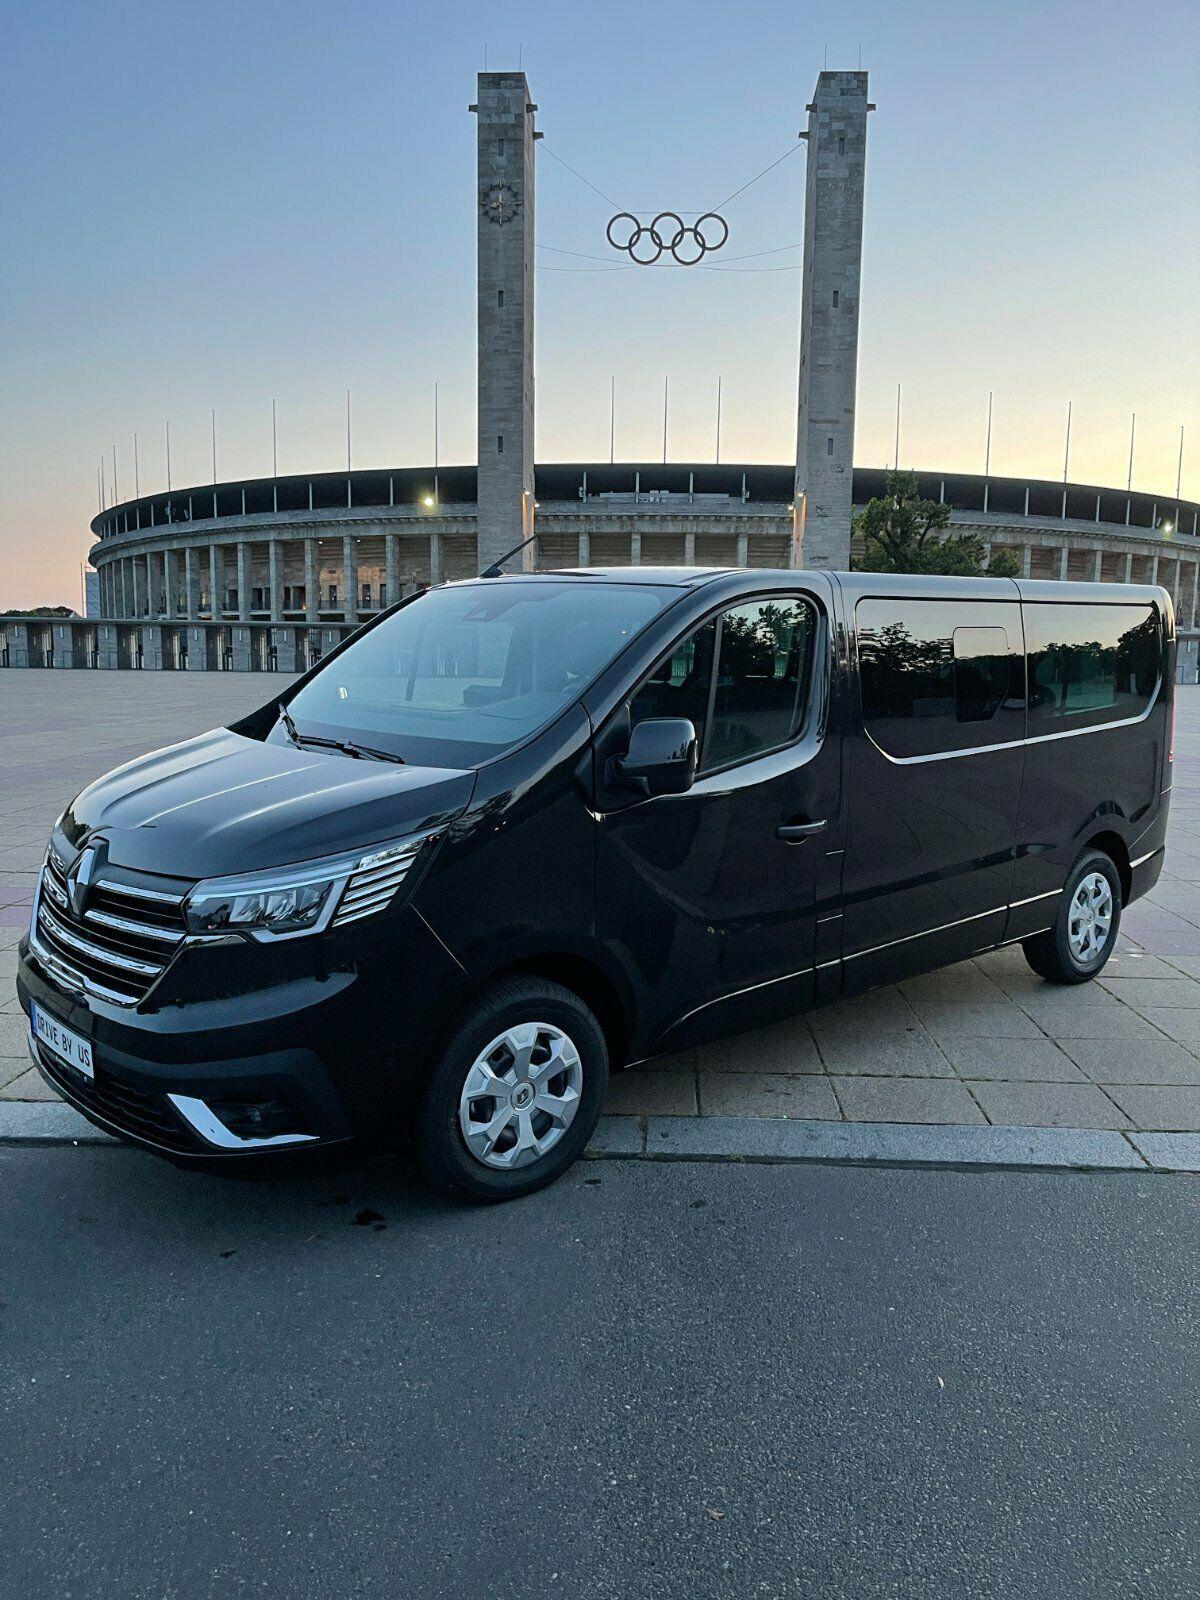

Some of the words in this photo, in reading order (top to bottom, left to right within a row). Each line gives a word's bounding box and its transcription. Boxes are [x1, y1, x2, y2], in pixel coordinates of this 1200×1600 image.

[37, 1013, 59, 1045] DRIVE
[62, 1034, 72, 1055] BY
[78, 1044, 91, 1066] US
